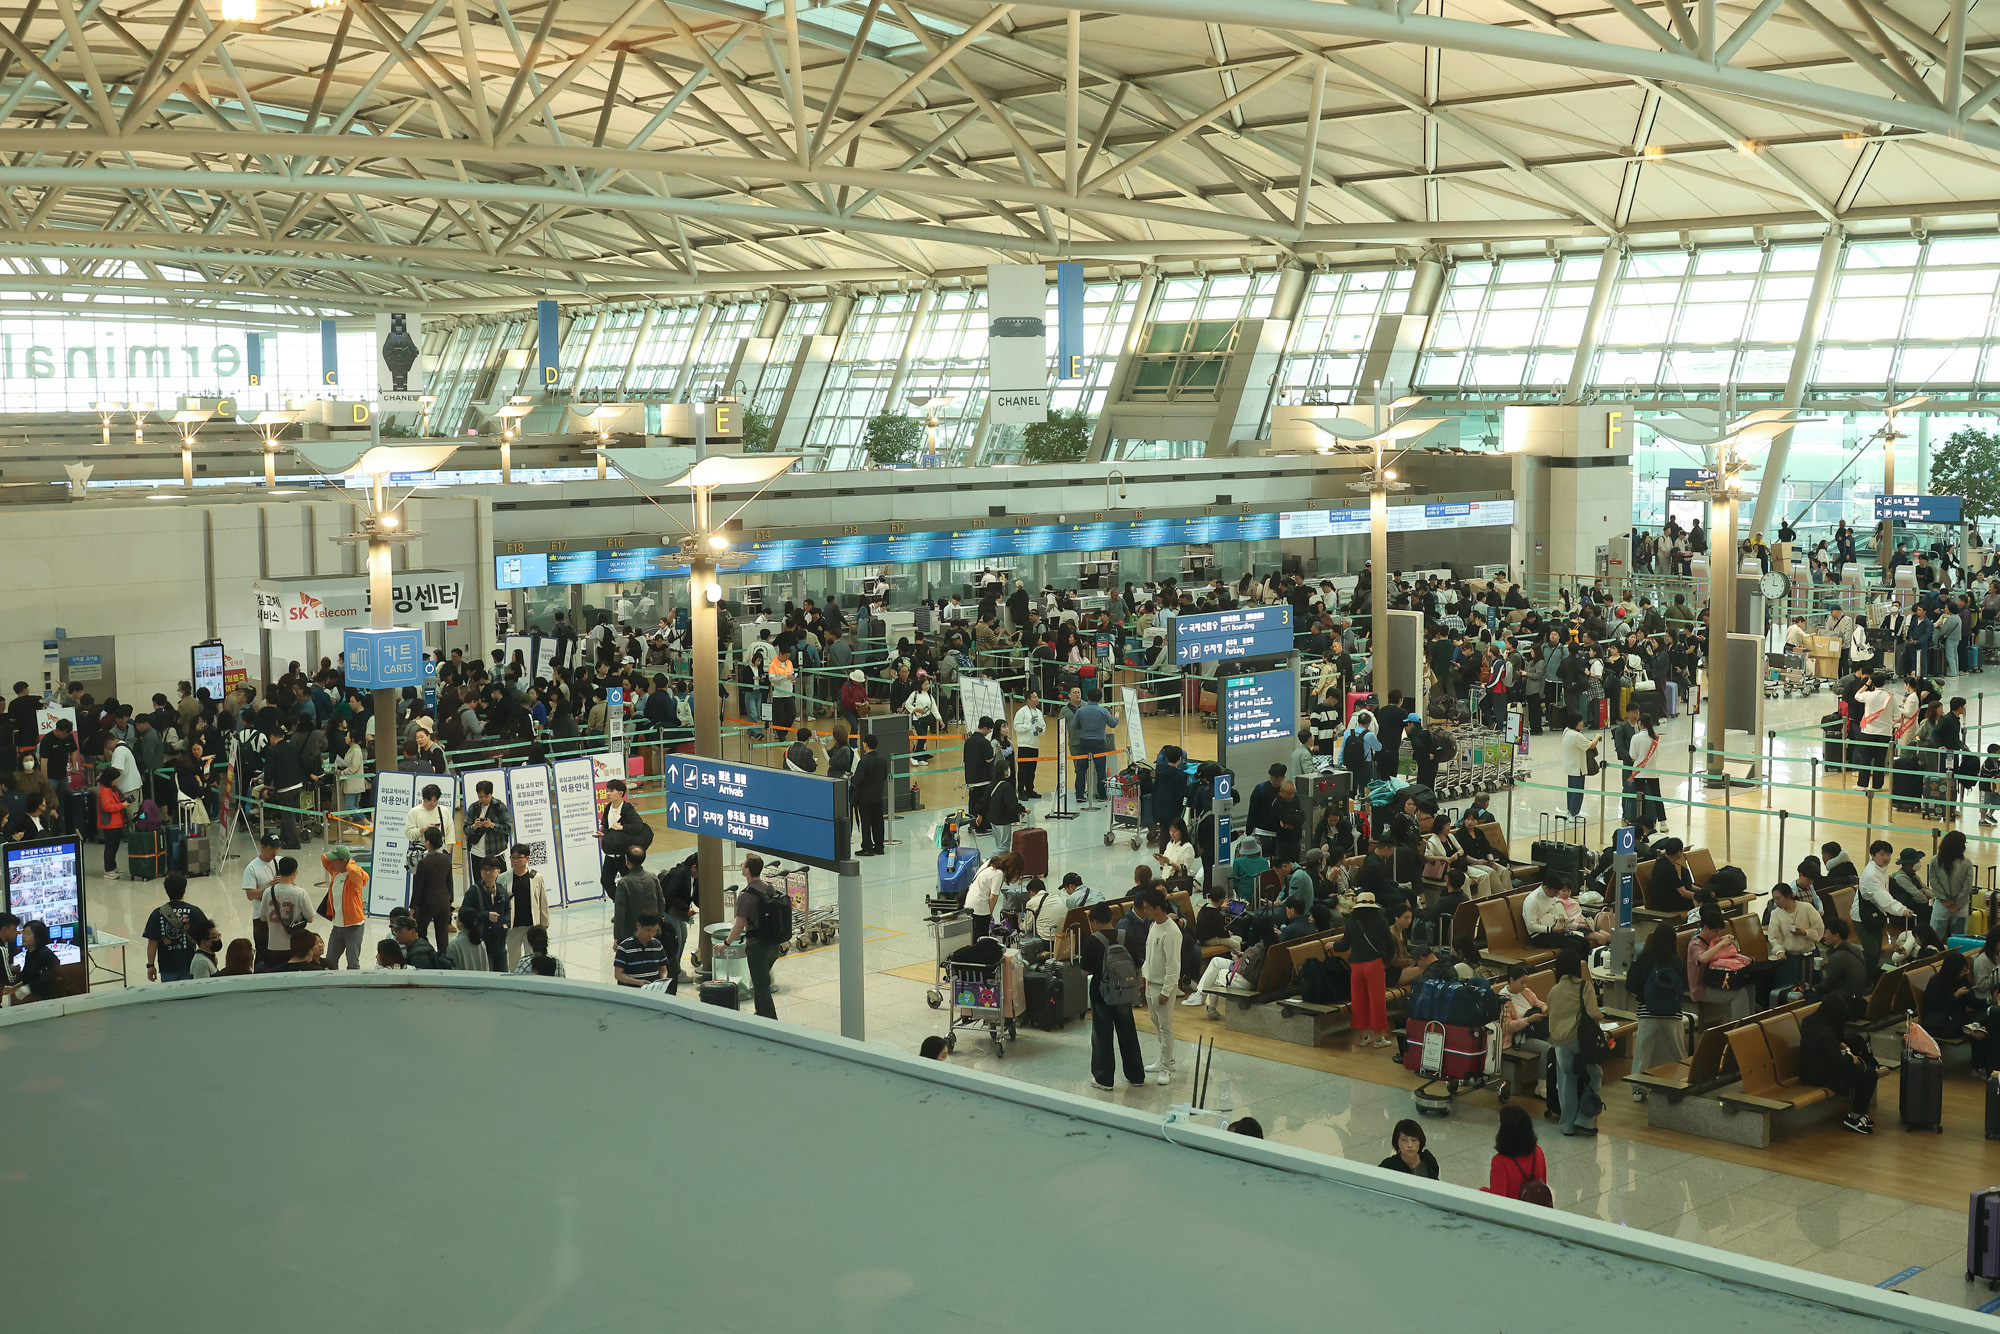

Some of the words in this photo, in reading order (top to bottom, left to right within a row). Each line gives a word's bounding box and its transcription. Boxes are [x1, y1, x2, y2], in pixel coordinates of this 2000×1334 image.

[1072, 355, 1082, 378] E
[326, 371, 336, 385] C
[546, 366, 558, 384] D
[250, 375, 258, 386] B
[998, 396, 1040, 406] CHANEL
[217, 400, 230, 416] C
[352, 404, 370, 424] D
[716, 408, 730, 433] E
[1607, 411, 1623, 449] F
[1206, 506, 1213, 515] F7
[1243, 504, 1250, 513] F6
[1094, 512, 1103, 521] F9
[1135, 510, 1143, 519] F8
[973, 520, 986, 528] F11
[1016, 516, 1030, 525] F10
[844, 526, 858, 534] F13
[891, 523, 905, 532] F12
[755, 530, 771, 539] F14
[507, 543, 524, 552] F18
[551, 541, 568, 550] F17
[608, 538, 624, 548] F16
[255, 593, 265, 606] 심
[364, 582, 460, 614] 밍센터
[290, 607, 310, 620] SK
[315, 607, 357, 618] telecom
[1282, 610, 1289, 624] 3
[1231, 622, 1255, 631] Boarding
[384, 644, 412, 661] 카트
[1204, 643, 1223, 655] 주차장
[1226, 647, 1245, 655] Parking
[384, 664, 412, 674] CARTS
[41, 721, 52, 730] SK
[559, 774, 589, 783] 유심교체서비스
[701, 773, 716, 787] 도착
[381, 788, 410, 796] 유심교체서비스
[561, 782, 589, 793] 이용안내
[719, 784, 744, 798] Arrivals
[381, 796, 409, 806] 이용안내
[703, 810, 724, 826] 주차장
[728, 824, 754, 840] Parking
